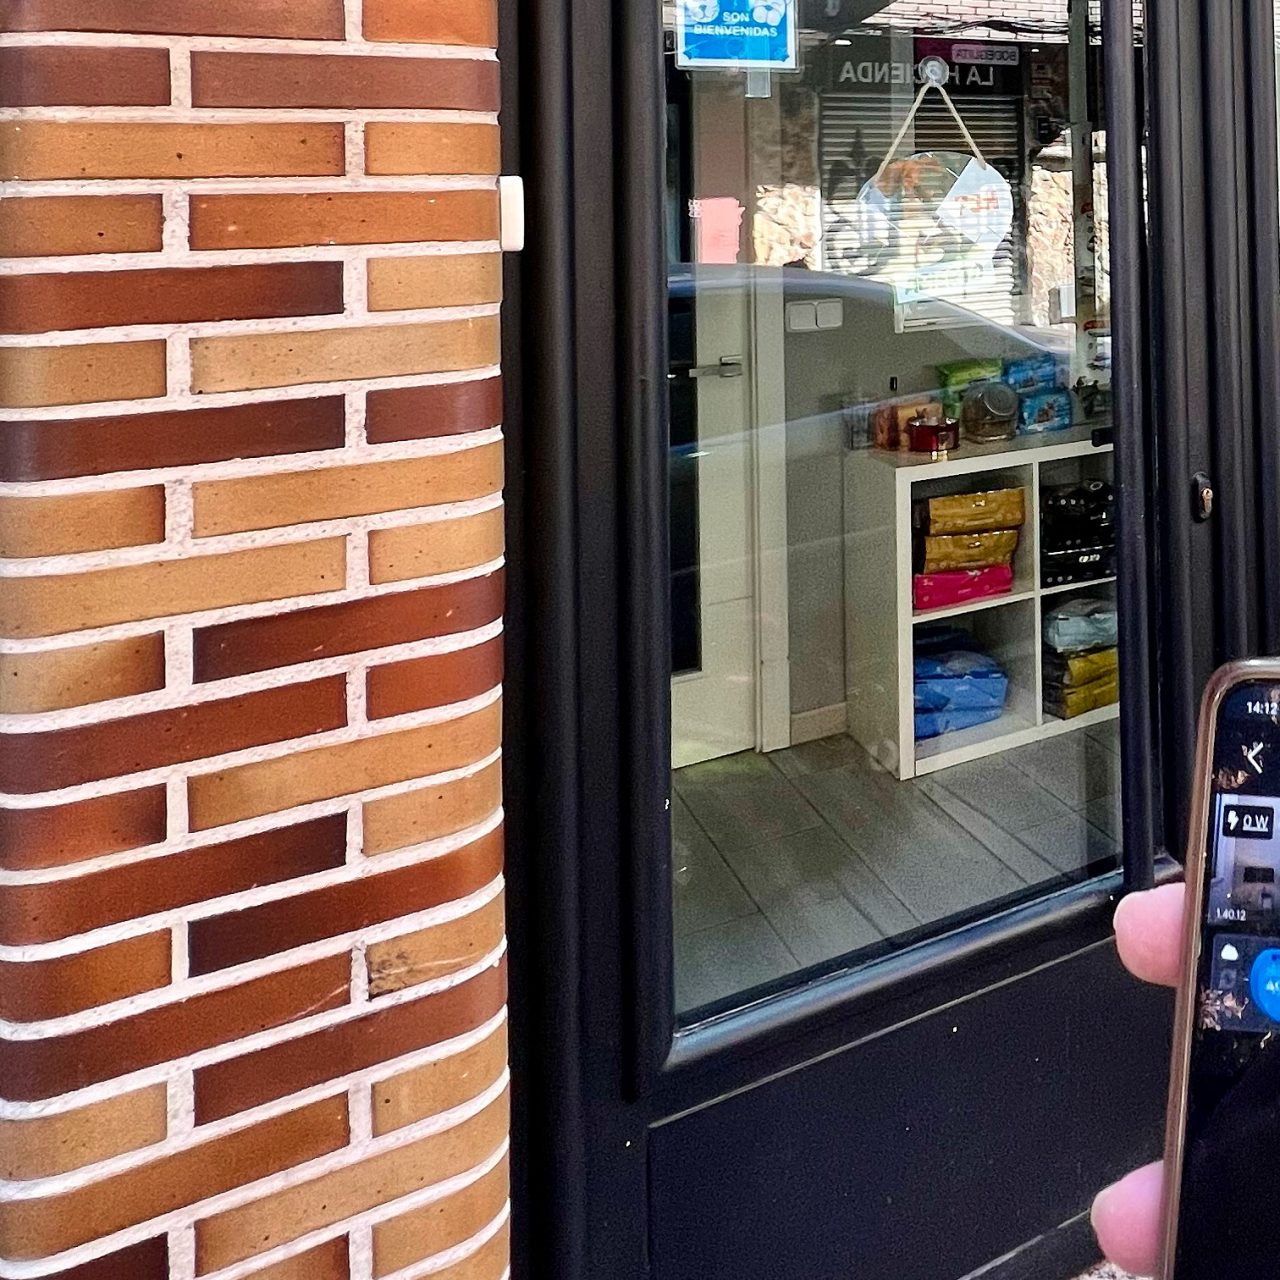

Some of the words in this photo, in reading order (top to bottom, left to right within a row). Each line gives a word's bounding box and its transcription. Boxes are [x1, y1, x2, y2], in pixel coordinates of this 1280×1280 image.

[722, 11, 750, 23] SON
[693, 24, 778, 38] BIENVENIDAS
[1246, 701, 1278, 715] 14:12
